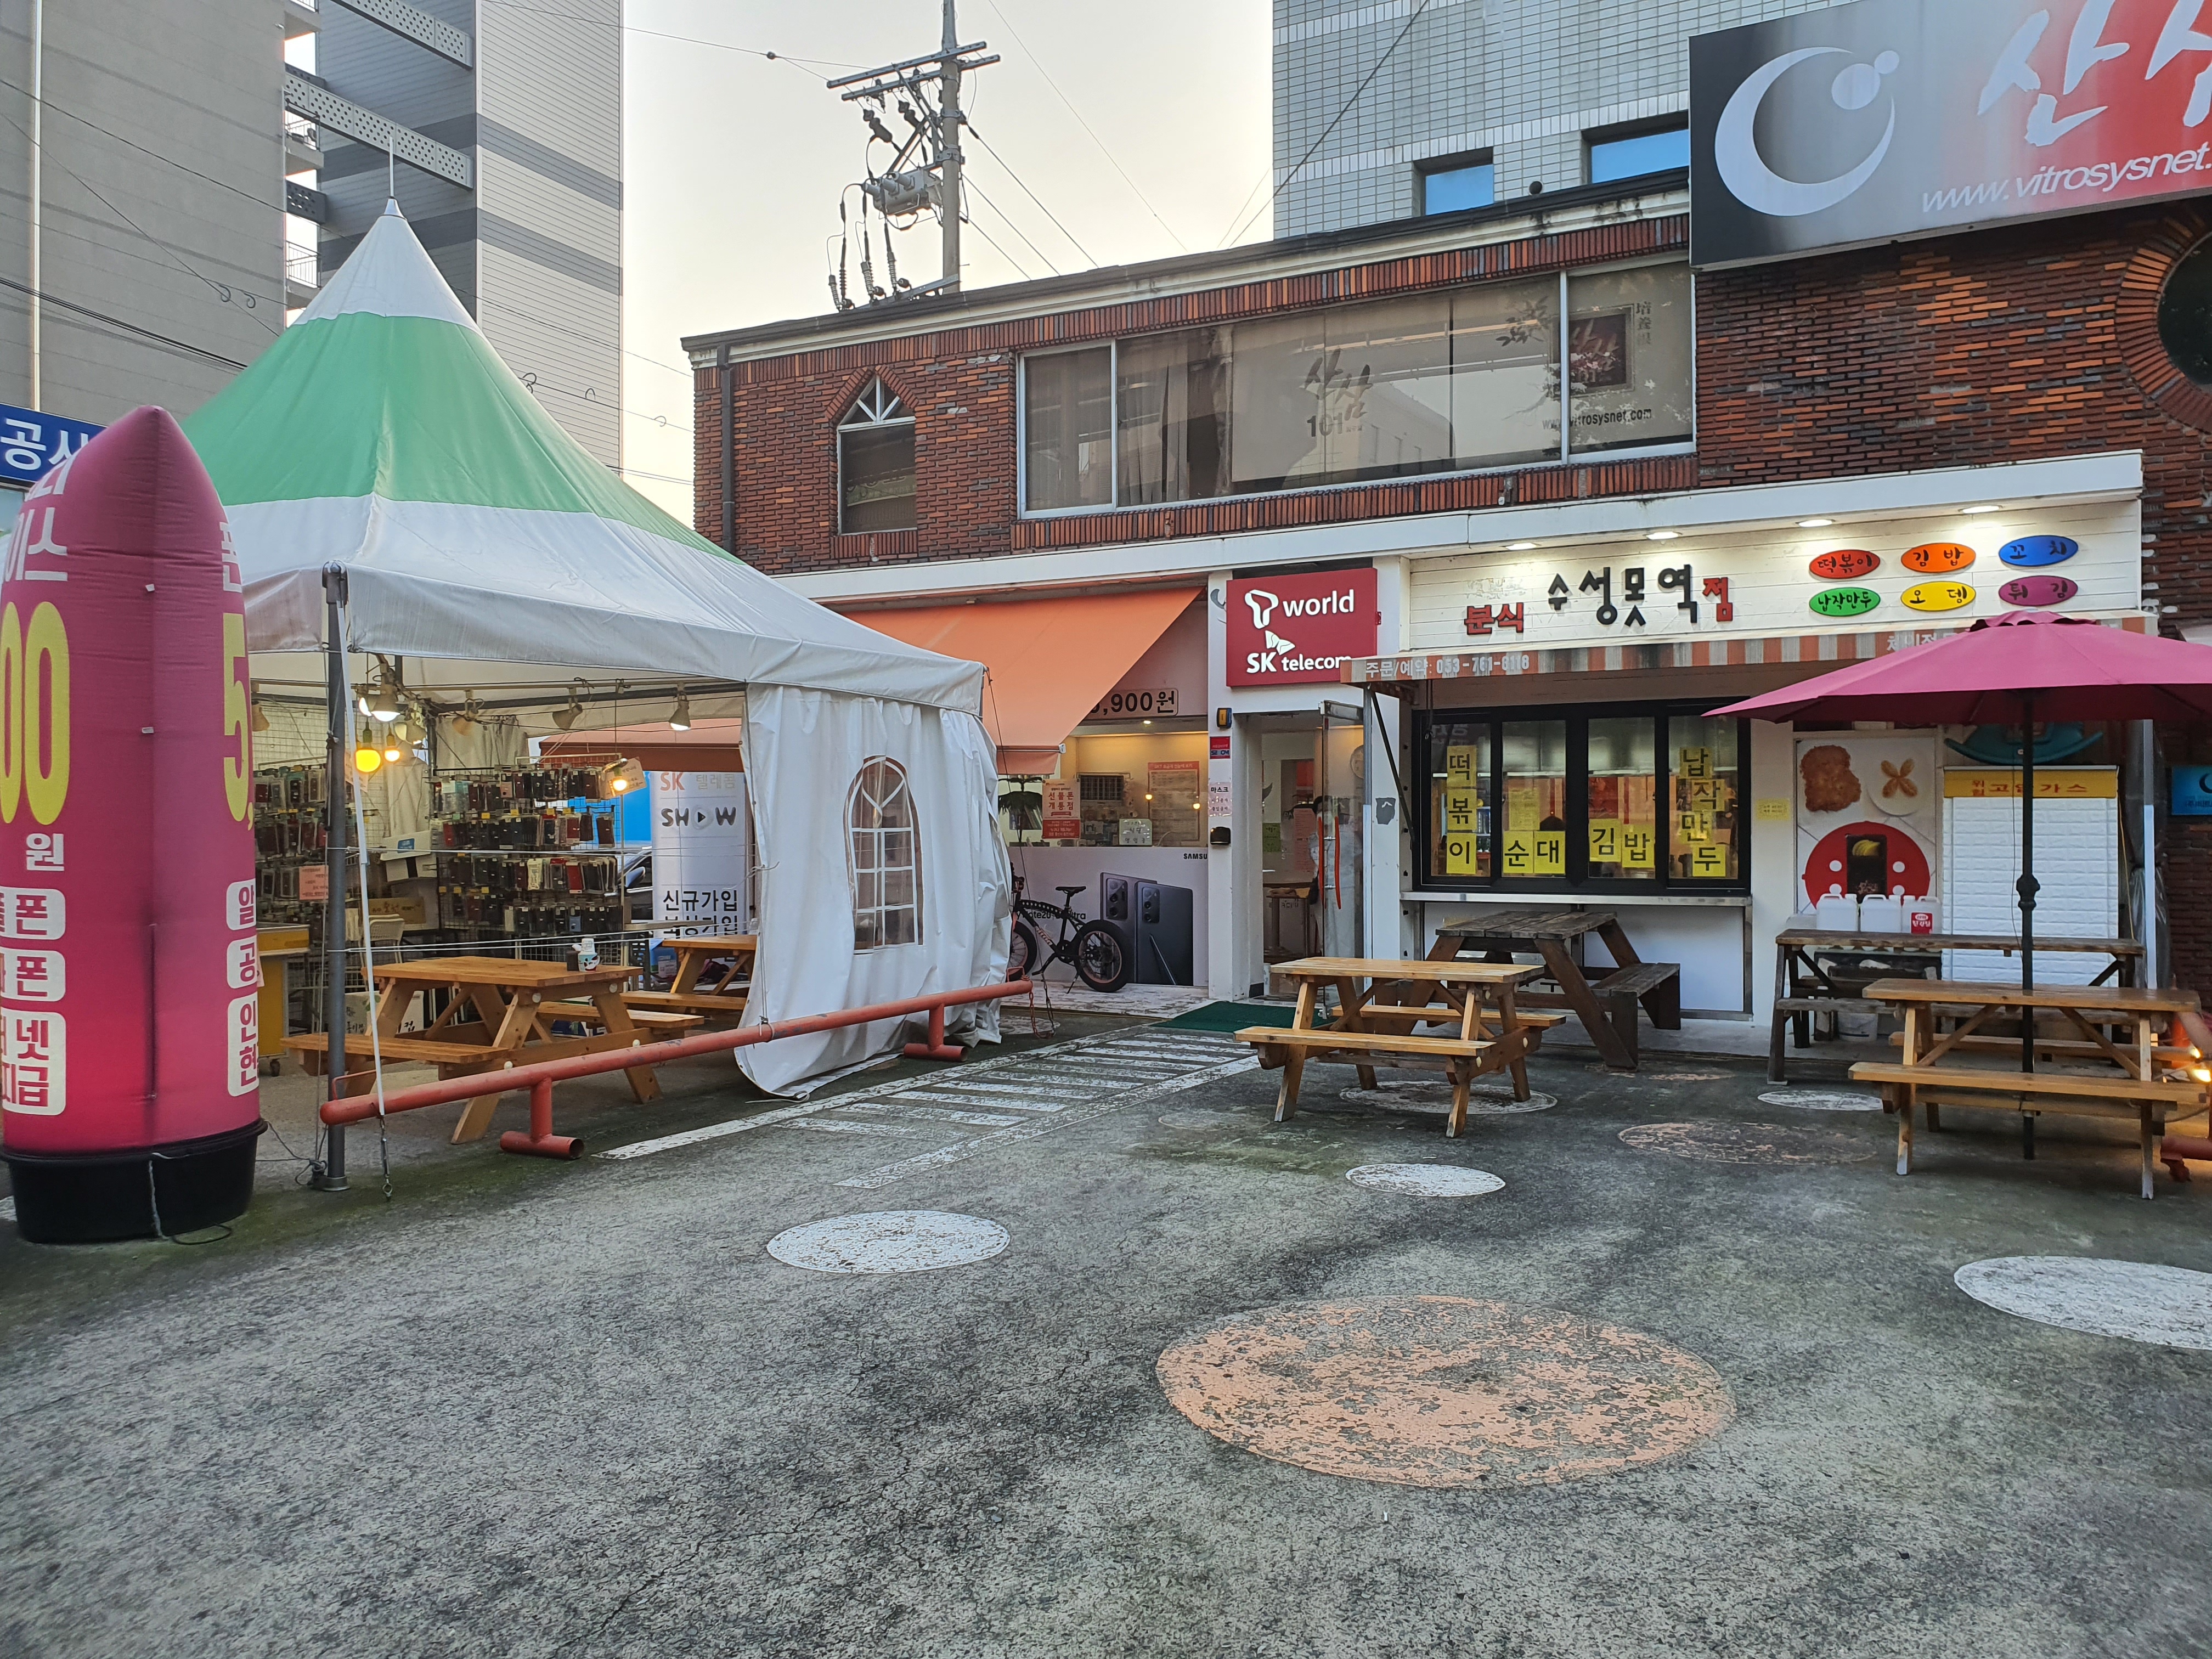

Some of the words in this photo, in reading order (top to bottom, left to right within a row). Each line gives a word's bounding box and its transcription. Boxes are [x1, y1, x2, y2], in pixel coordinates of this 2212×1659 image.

[1818, 552, 1872, 573] 떡볶이
[1283, 589, 1355, 618] world
[1818, 591, 1872, 612] 납작만두
[1464, 601, 1524, 635] 분식
[1246, 651, 1278, 674] SK
[660, 772, 685, 791] SK
[1449, 753, 1473, 865] 떡볶이
[26, 833, 65, 871] 원
[1504, 840, 1559, 867] 순대
[1592, 827, 1650, 861] 김밥
[0, 892, 48, 935] 폰
[663, 889, 738, 912] 신규가입
[0, 953, 48, 997] 폰
